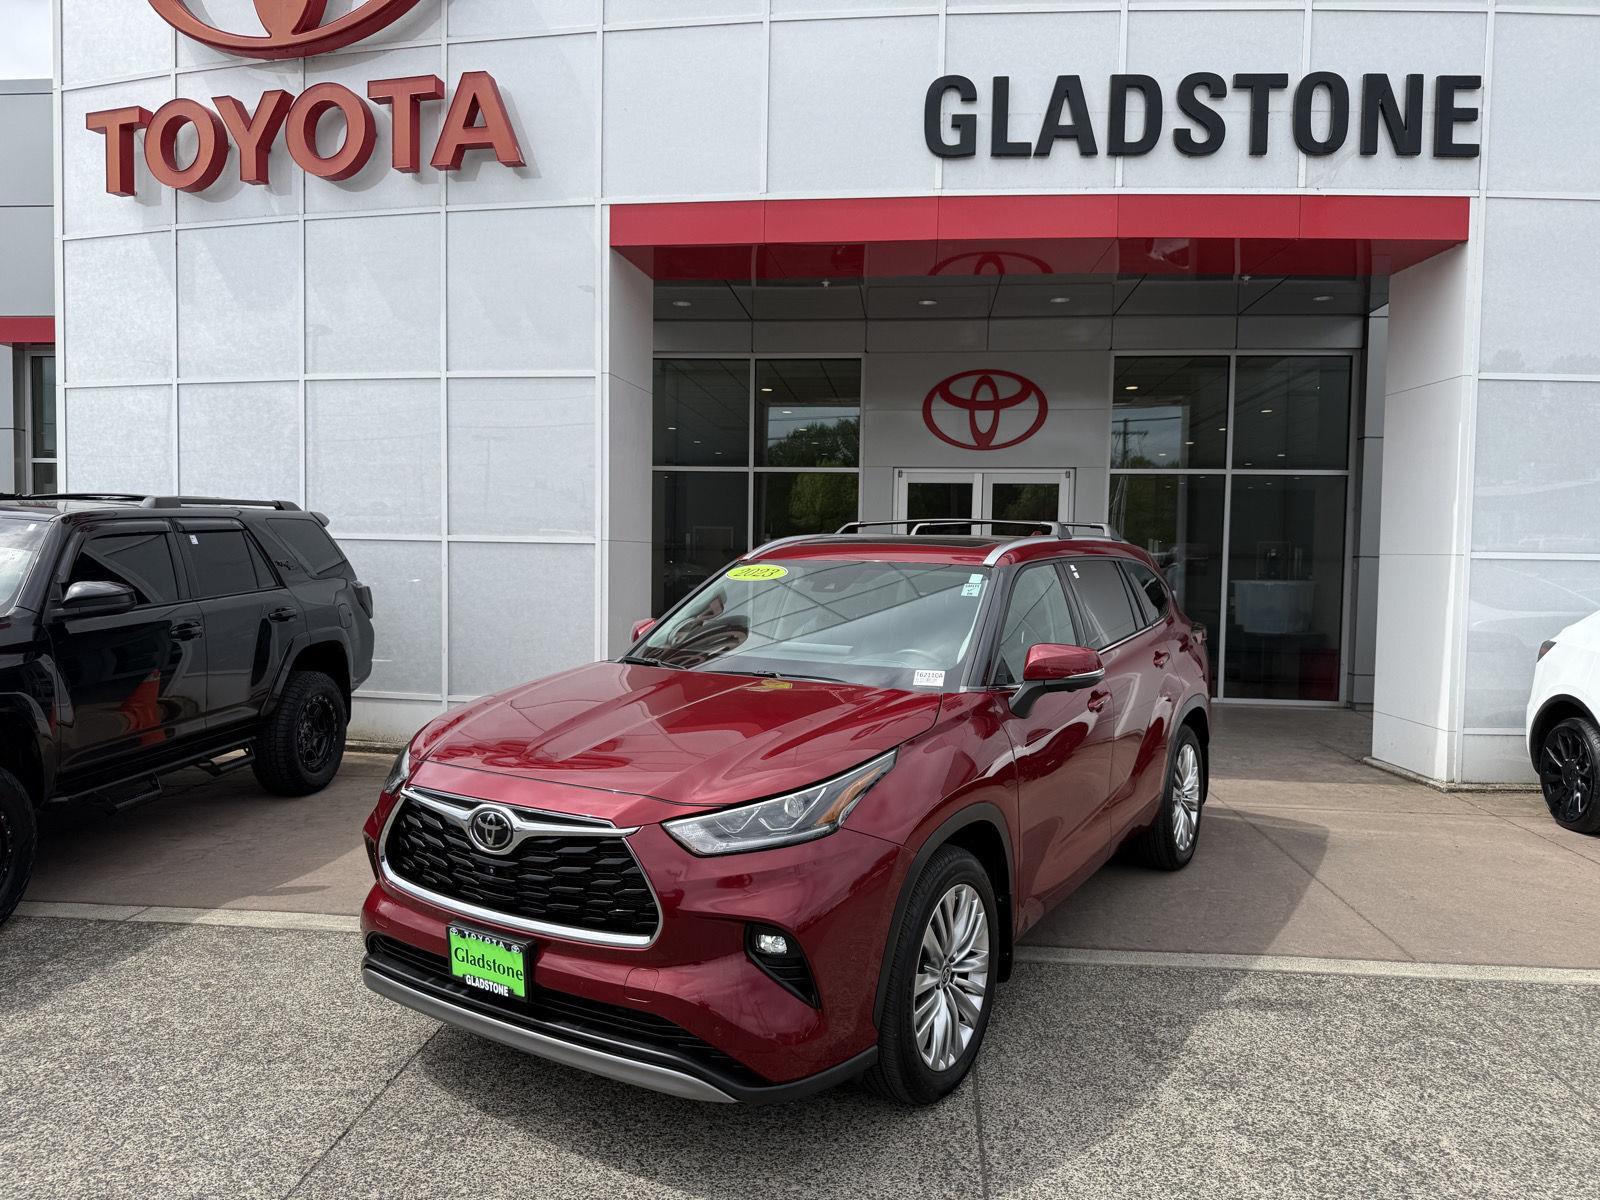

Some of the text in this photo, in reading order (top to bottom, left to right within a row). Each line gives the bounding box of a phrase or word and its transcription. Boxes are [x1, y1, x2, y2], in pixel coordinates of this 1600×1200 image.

[924, 71, 1481, 158] GLADSTONE
[86, 71, 526, 197] TOYOTA
[464, 931, 505, 948] TOYOTA
[454, 947, 523, 980] Gladstone
[466, 975, 508, 996] GLADSTONE
